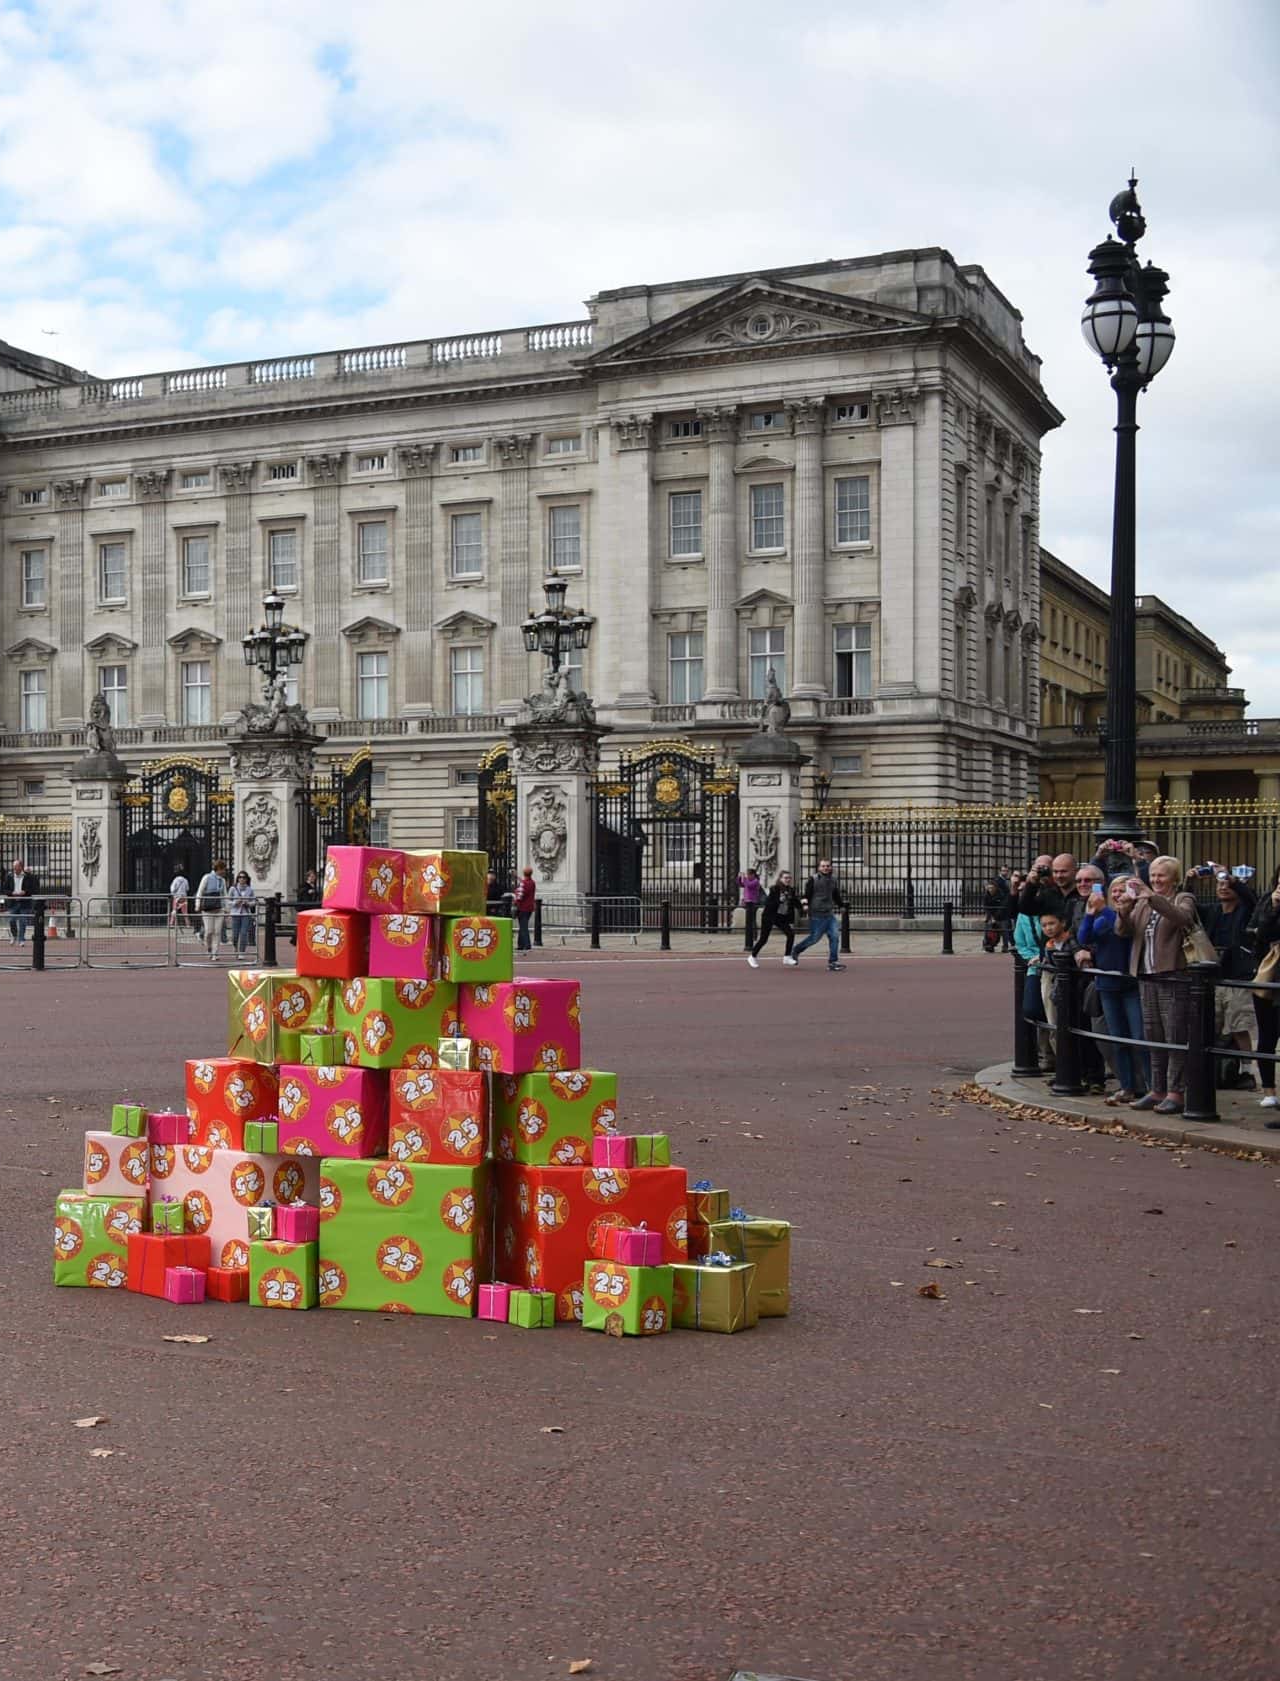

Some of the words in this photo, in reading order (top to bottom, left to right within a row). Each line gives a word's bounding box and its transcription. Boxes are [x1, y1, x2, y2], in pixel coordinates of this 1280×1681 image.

[371, 863, 393, 897] 25
[423, 865, 446, 894] 25
[311, 923, 341, 947] 25
[387, 914, 419, 935] 25
[459, 928, 492, 949] 25
[247, 1003, 264, 1032] 25
[278, 991, 305, 1020] 25
[515, 995, 530, 1028] 25
[366, 1016, 386, 1048] 25
[195, 1062, 214, 1083] 25
[229, 1078, 254, 1107] 25
[279, 1083, 301, 1116] 25
[401, 1073, 434, 1102] 25
[333, 1106, 362, 1138] 25
[448, 1118, 479, 1150] 25
[520, 1107, 543, 1135] 25
[392, 1130, 423, 1161] 25
[236, 1172, 258, 1194] 25
[280, 1166, 299, 1196] 25
[376, 1166, 405, 1200] 25
[592, 1167, 620, 1197] 25
[112, 1211, 142, 1235] 25
[188, 1197, 207, 1227] 25
[538, 1194, 555, 1226] 25
[383, 1246, 417, 1272] 25
[93, 1262, 126, 1288] 25
[594, 1272, 624, 1295] 25
[266, 1280, 296, 1300] 25
[644, 1309, 663, 1330] 25
